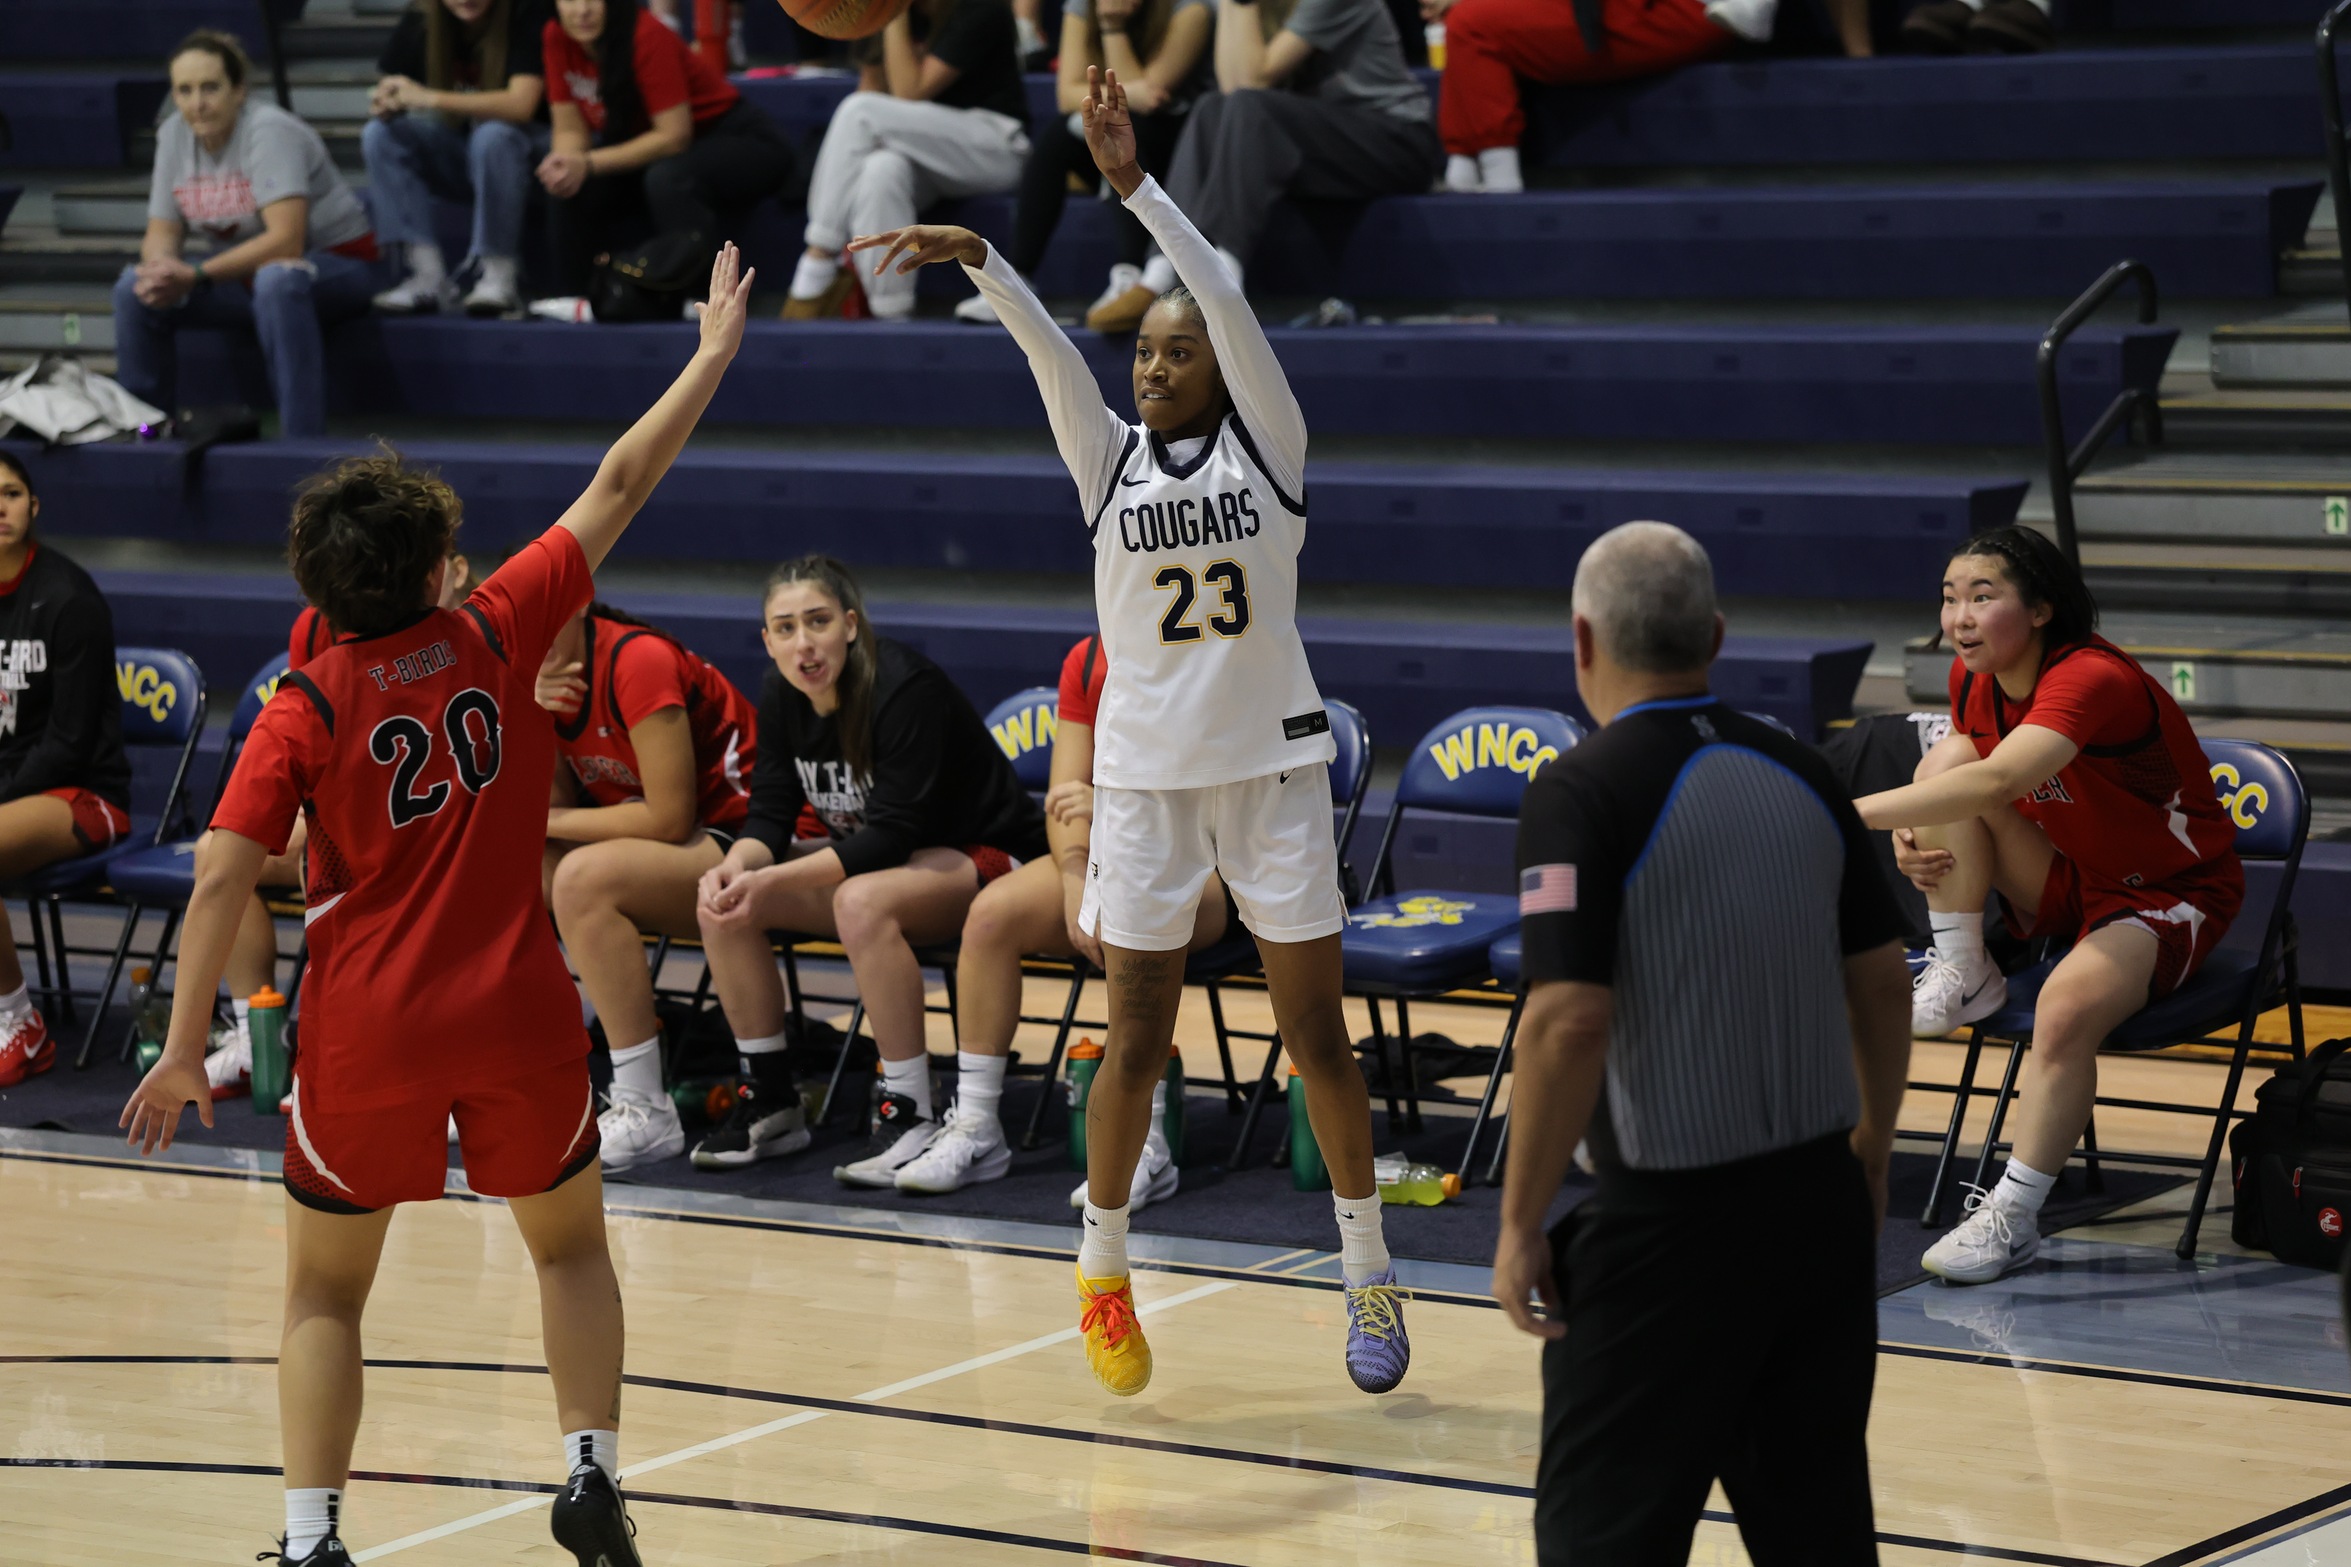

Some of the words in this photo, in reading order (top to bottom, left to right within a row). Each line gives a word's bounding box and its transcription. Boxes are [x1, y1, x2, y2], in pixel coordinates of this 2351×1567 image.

[1119, 488, 1260, 552] COUGARS
[1152, 557, 1252, 646] 23
[115, 661, 177, 723] NCC
[368, 640, 457, 692] T-BIRDS
[990, 703, 1059, 761] WN
[1313, 717, 1323, 727] M
[369, 687, 502, 829] 20
[2209, 762, 2269, 830] CC
